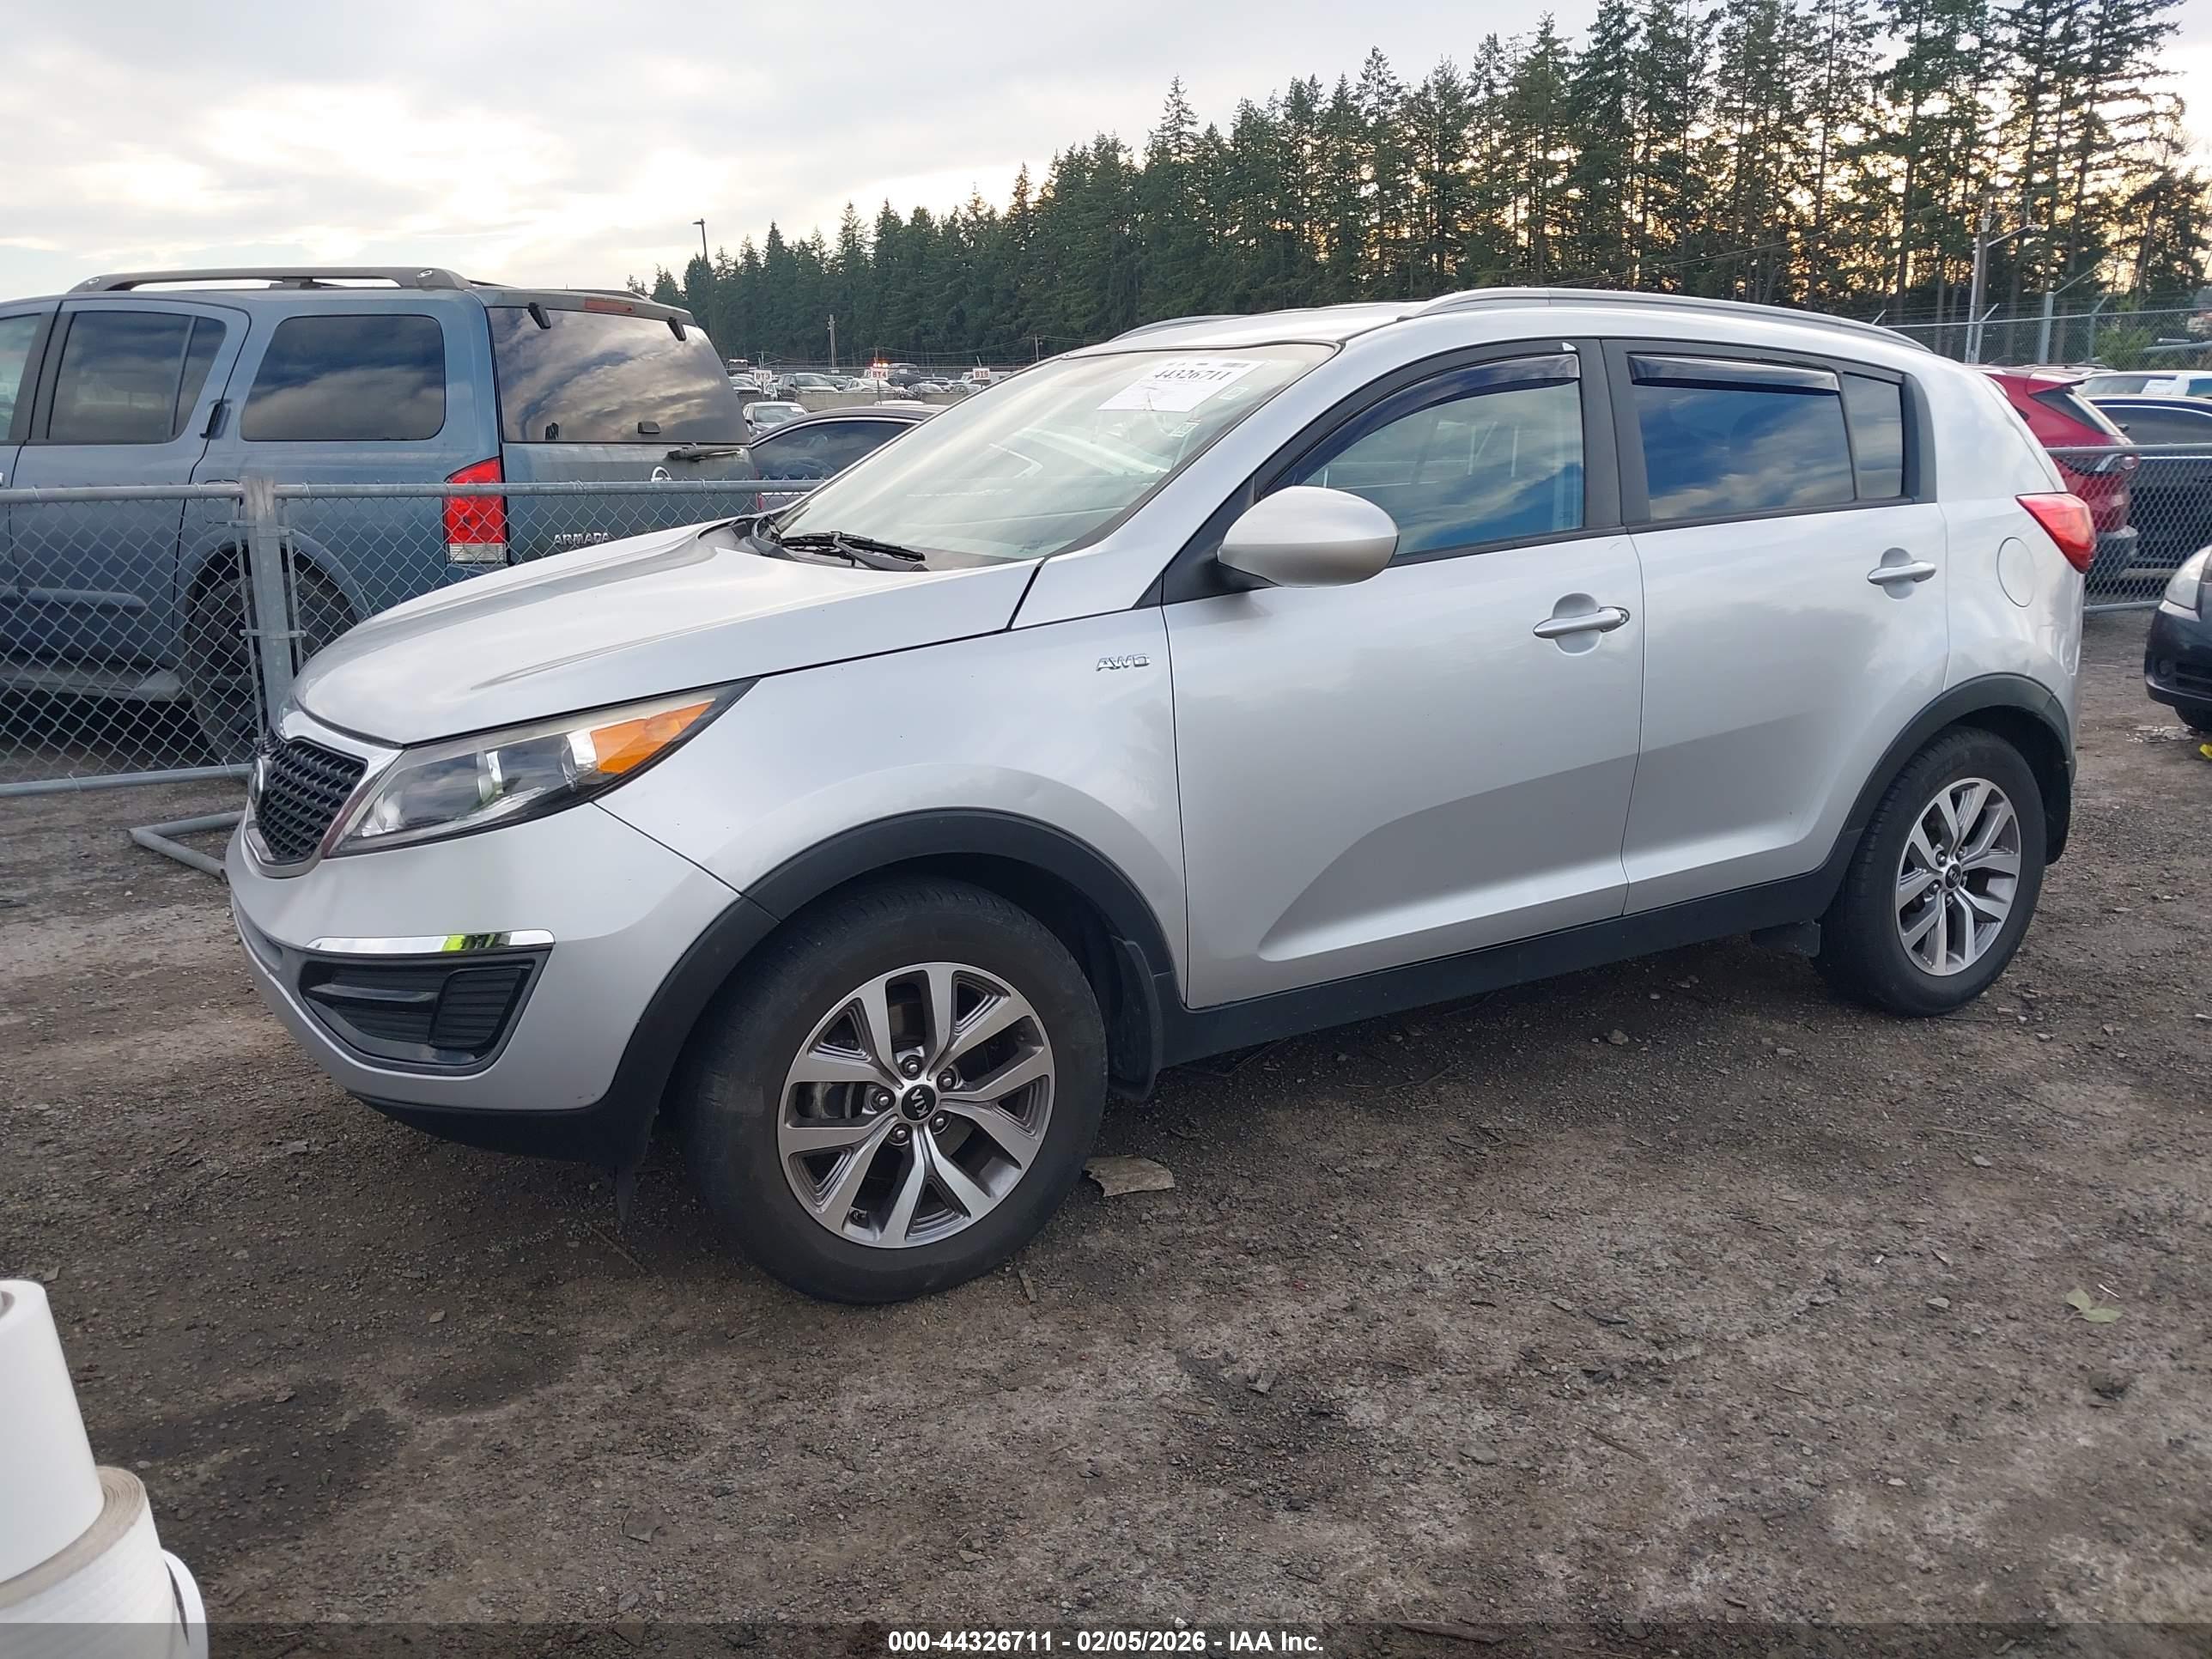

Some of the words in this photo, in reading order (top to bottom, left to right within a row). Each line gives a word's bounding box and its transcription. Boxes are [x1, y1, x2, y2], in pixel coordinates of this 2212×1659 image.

[553, 532, 610, 544] ARMADA
[1096, 653, 1151, 672] AWD
[910, 1088, 928, 1118] KIA
